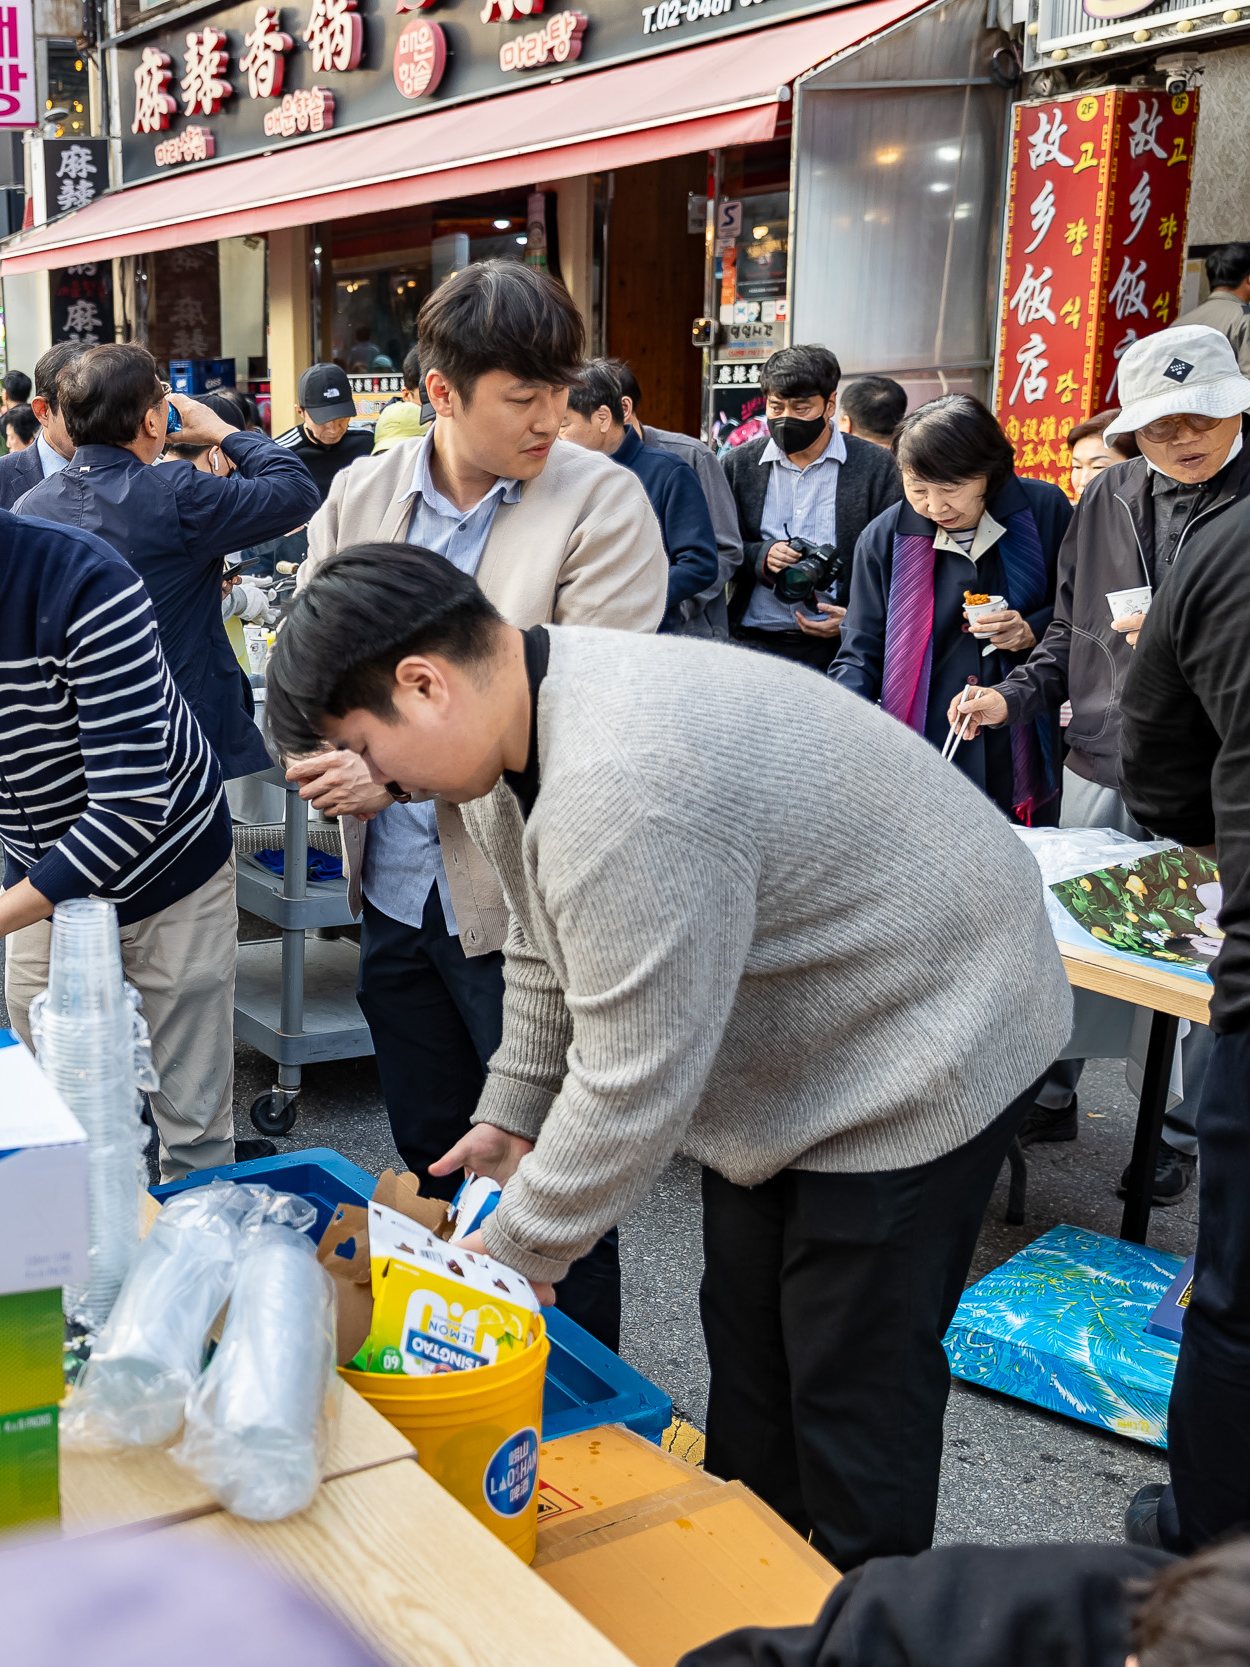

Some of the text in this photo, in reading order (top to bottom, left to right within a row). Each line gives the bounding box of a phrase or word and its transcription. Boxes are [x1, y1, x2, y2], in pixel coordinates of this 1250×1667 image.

[500, 11, 588, 72] 마라탕
[1080, 101, 1095, 116] 2F
[1173, 96, 1188, 110] 2F
[1009, 108, 1075, 406] 故乡饭店
[1054, 141, 1099, 404] 고향식당
[428, 1320, 476, 1346] LEMON
[383, 1354, 400, 1370] 60
